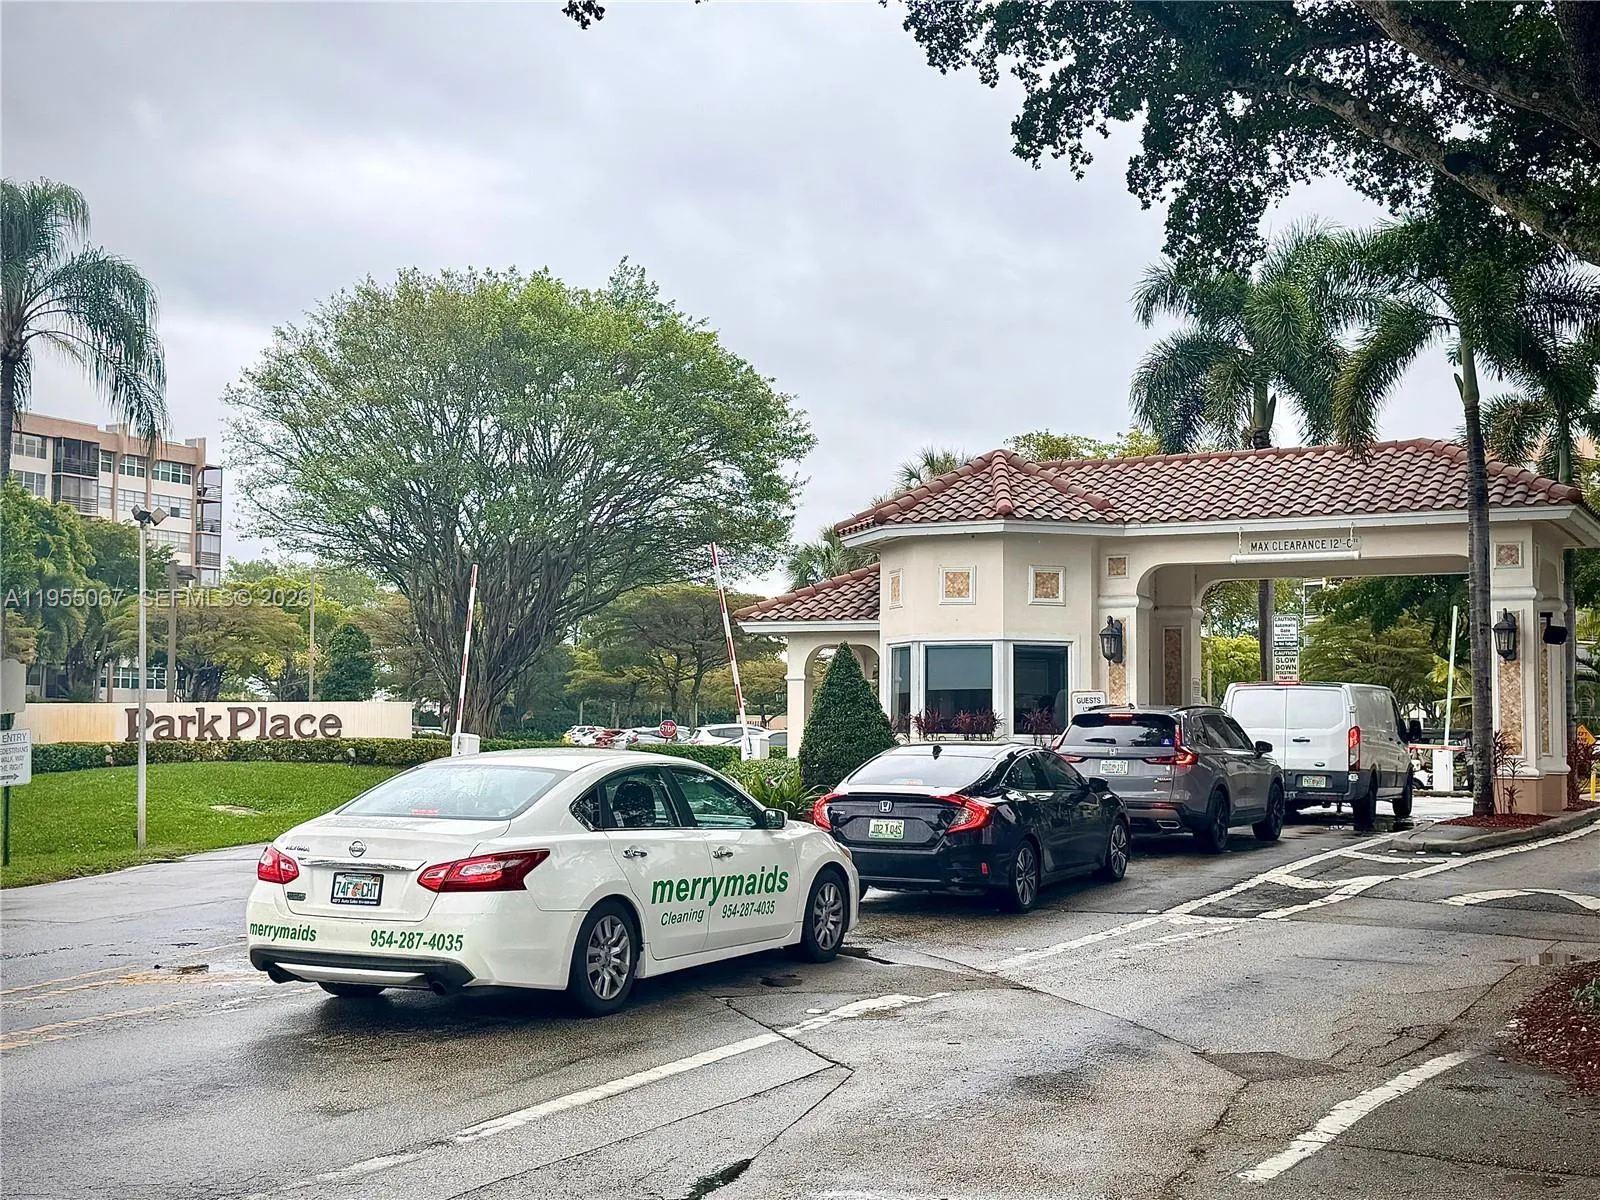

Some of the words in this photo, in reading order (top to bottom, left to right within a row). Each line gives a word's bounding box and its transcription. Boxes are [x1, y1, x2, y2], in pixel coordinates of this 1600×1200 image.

[1250, 541, 1269, 552] MAX
[1272, 539, 1327, 551] CLEARANCE
[2, 732, 27, 743] ENTRY
[660, 724, 676, 734] STOP
[336, 881, 352, 896] 74F
[361, 882, 378, 898] CHT
[651, 865, 789, 907] merrymaids
[661, 908, 704, 926] Cleaning
[722, 900, 776, 918] 954-287-4035
[249, 921, 317, 942] merrymaids
[370, 930, 464, 951] 954-287-4035
